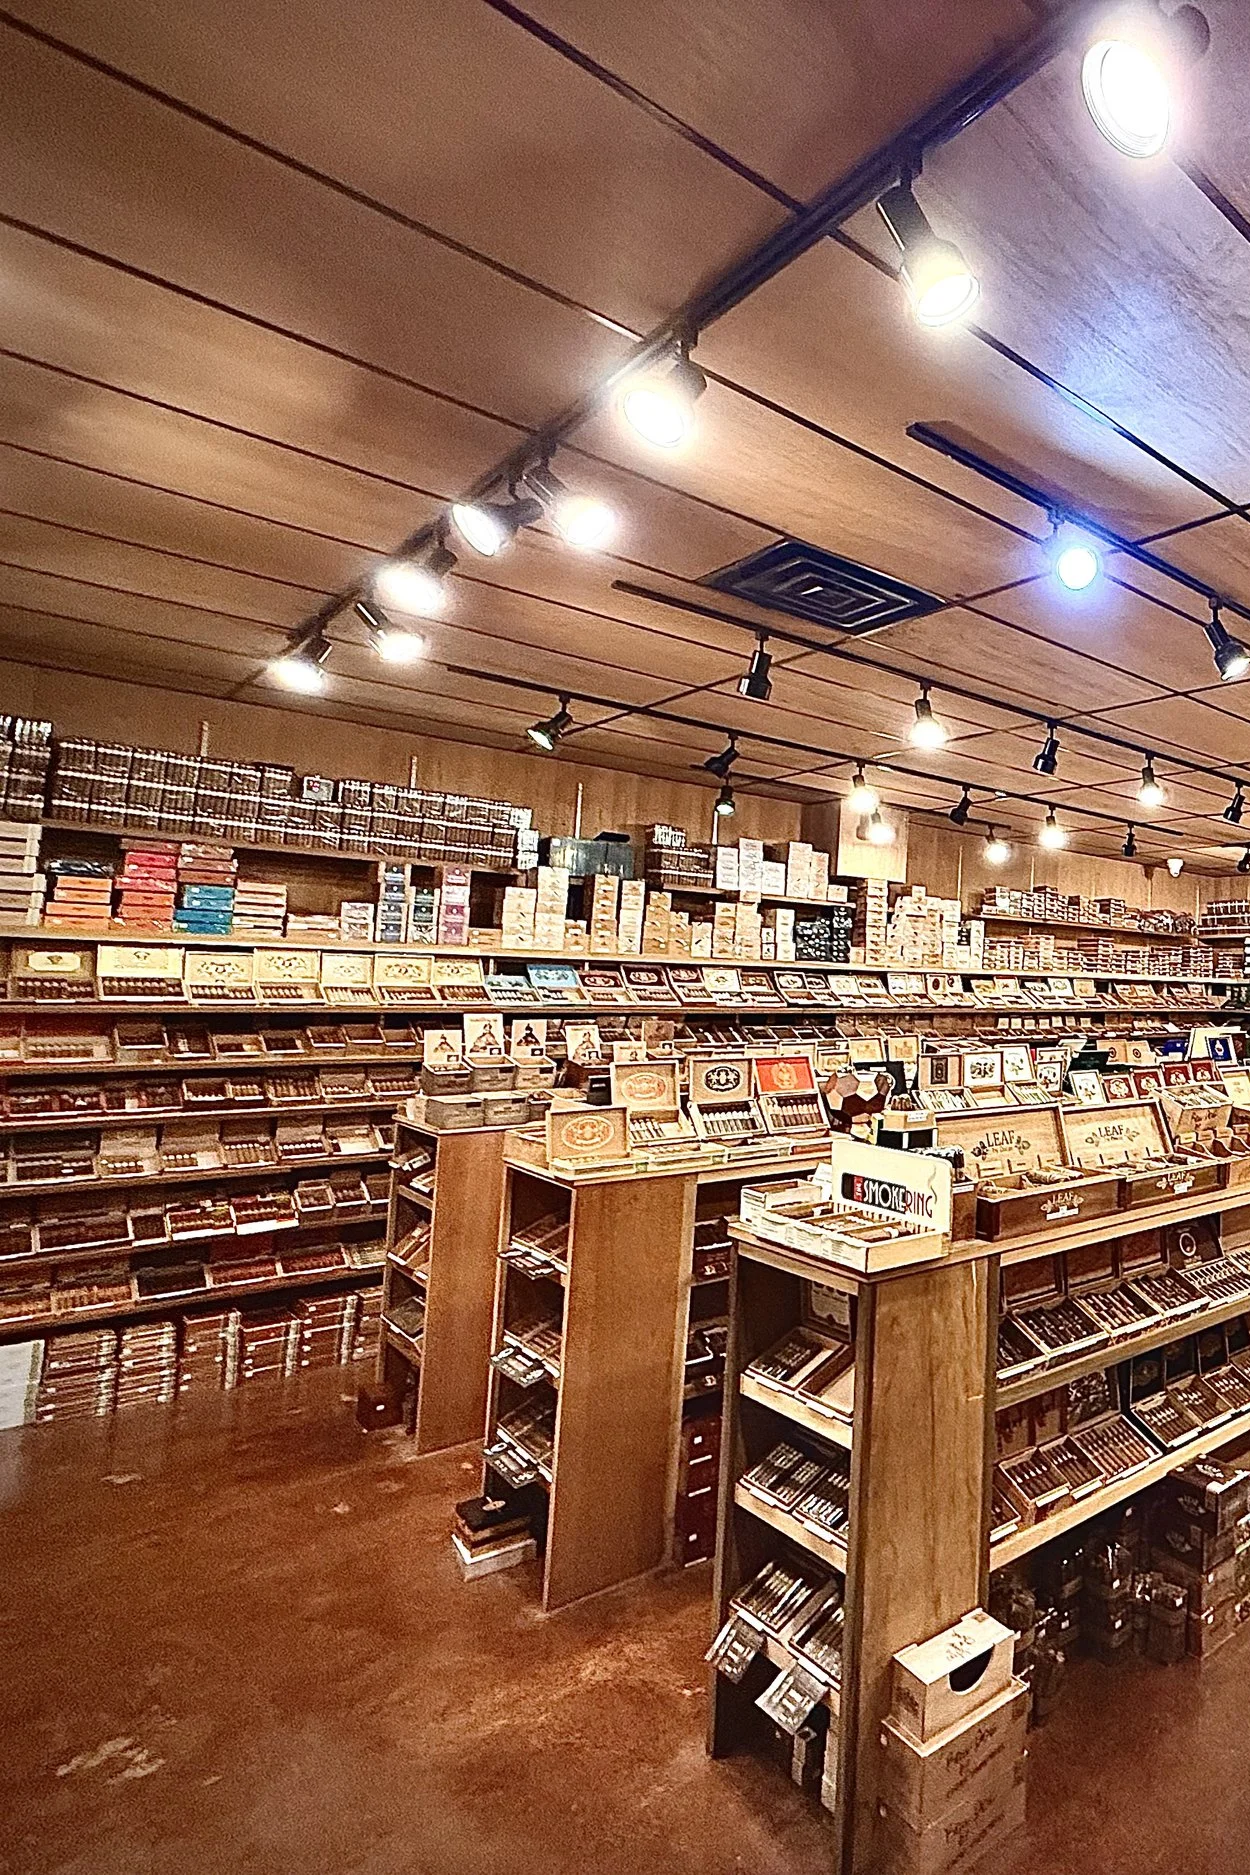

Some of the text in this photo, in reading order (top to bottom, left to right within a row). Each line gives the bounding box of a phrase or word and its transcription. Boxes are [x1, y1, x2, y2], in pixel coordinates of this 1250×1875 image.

[1097, 1124, 1124, 1137] LEAF
[985, 1130, 1015, 1147] LEAF
[1052, 1190, 1074, 1205] LEAF
